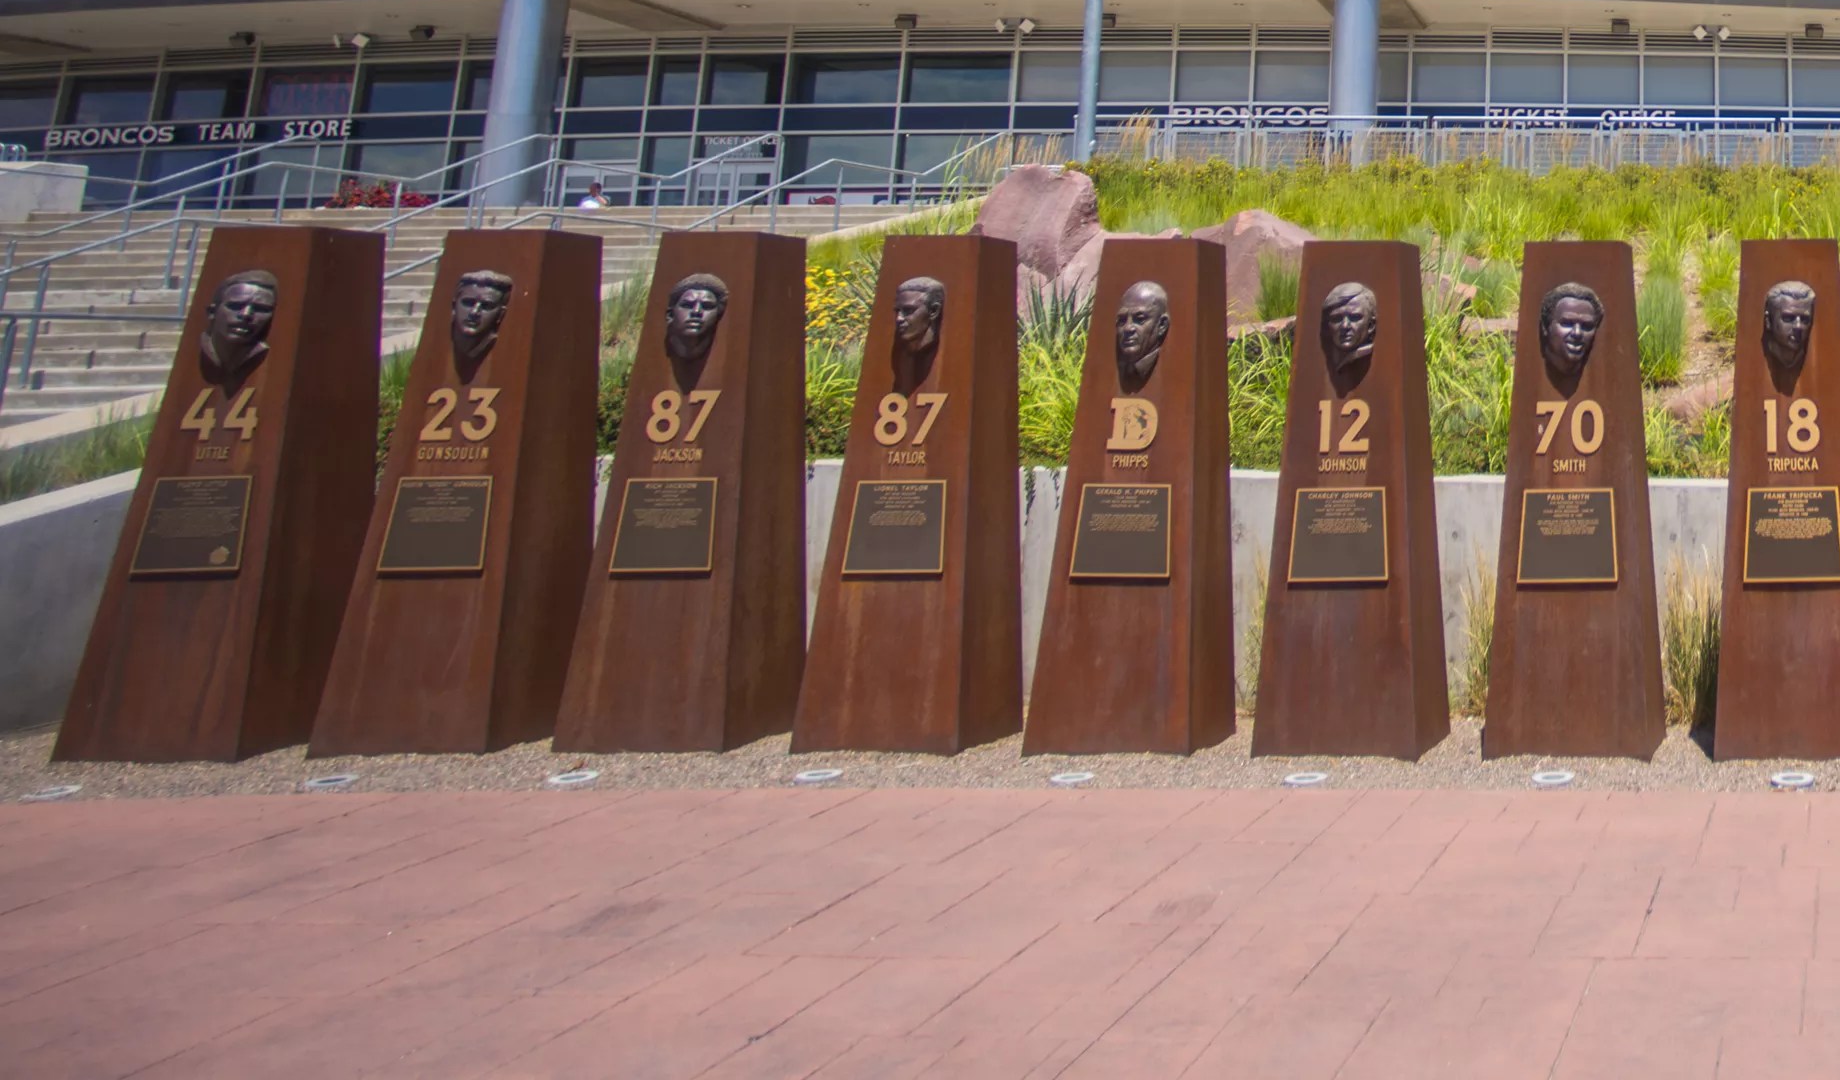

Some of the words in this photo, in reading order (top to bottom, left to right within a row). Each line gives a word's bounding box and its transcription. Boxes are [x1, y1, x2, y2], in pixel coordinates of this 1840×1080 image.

[1172, 106, 1329, 126] BRONCOS
[1489, 108, 1569, 127] TICKET
[45, 125, 175, 147] BRONCOS
[199, 122, 256, 141] TEAM
[284, 119, 353, 139] STORE
[180, 387, 258, 440] 44
[420, 388, 501, 440] 23
[646, 390, 722, 442] 87
[874, 392, 948, 446] 87
[1106, 398, 1158, 450] D
[1319, 398, 1370, 453] 12
[1764, 399, 1820, 452] 18
[1535, 400, 1604, 454] 70
[195, 446, 230, 460] LITTLE
[418, 446, 490, 460] GONSOULIN
[653, 448, 703, 462] JACKSON
[888, 451, 926, 464] TAYLOR
[1112, 454, 1148, 468] PHIPPS
[1318, 458, 1367, 472] JOHNSON
[1768, 458, 1819, 471] TRIPUCKA
[1553, 459, 1586, 472] SMITH
